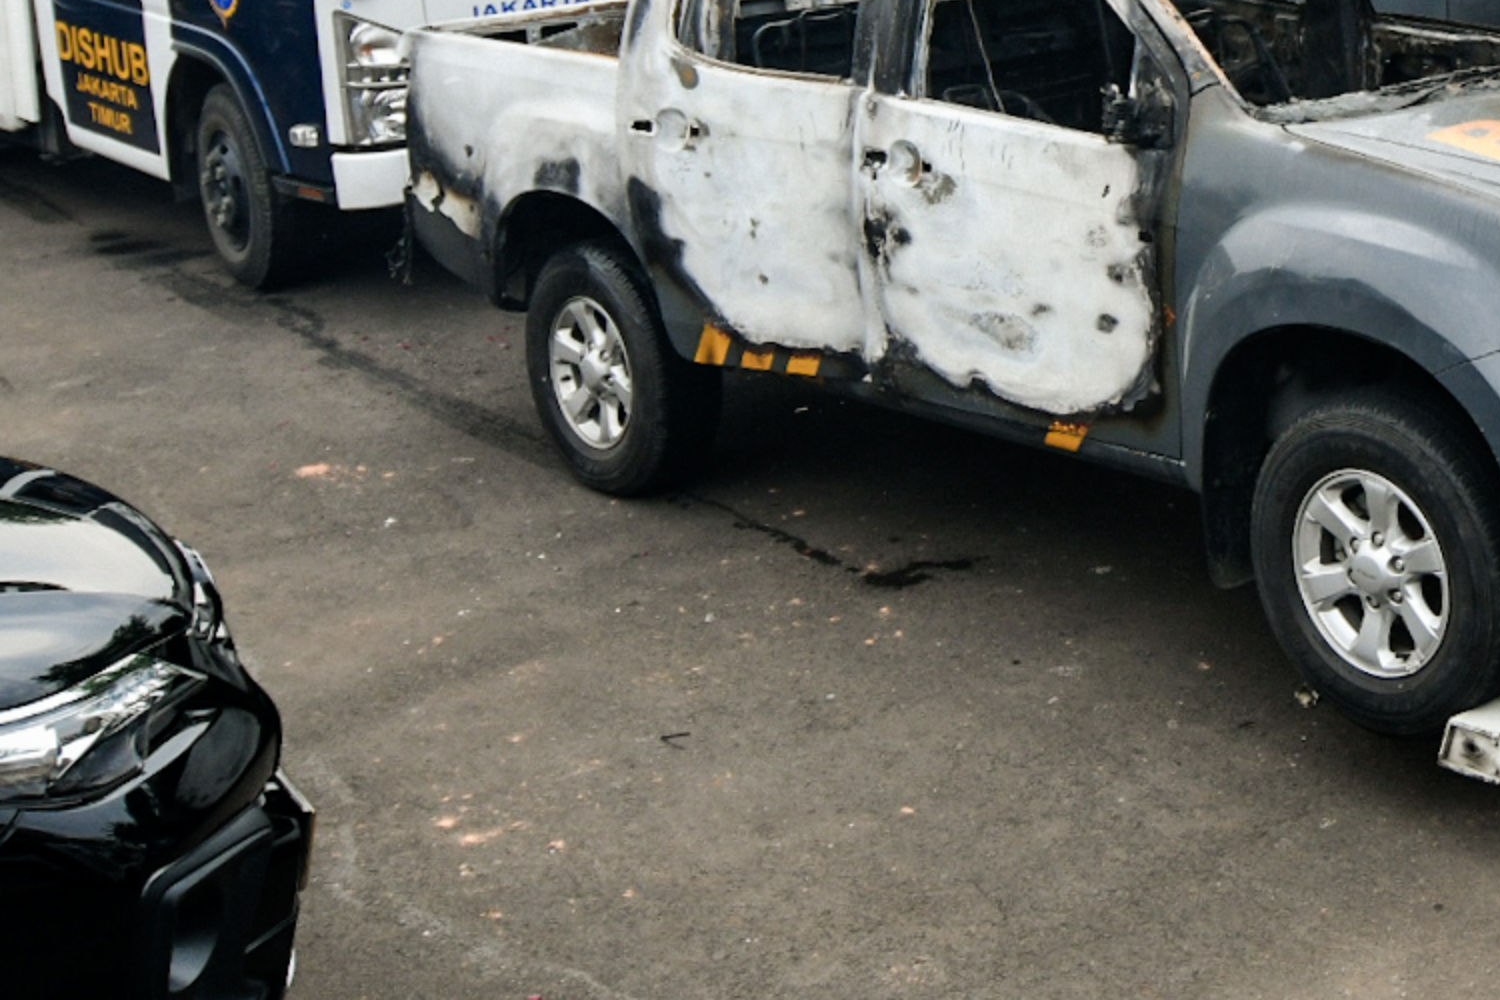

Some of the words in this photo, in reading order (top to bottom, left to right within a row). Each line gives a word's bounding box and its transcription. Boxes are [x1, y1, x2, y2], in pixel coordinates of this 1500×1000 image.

[56, 21, 150, 86] DISHUB
[77, 72, 138, 110] JAKARTA
[88, 101, 133, 134] TIMUR
